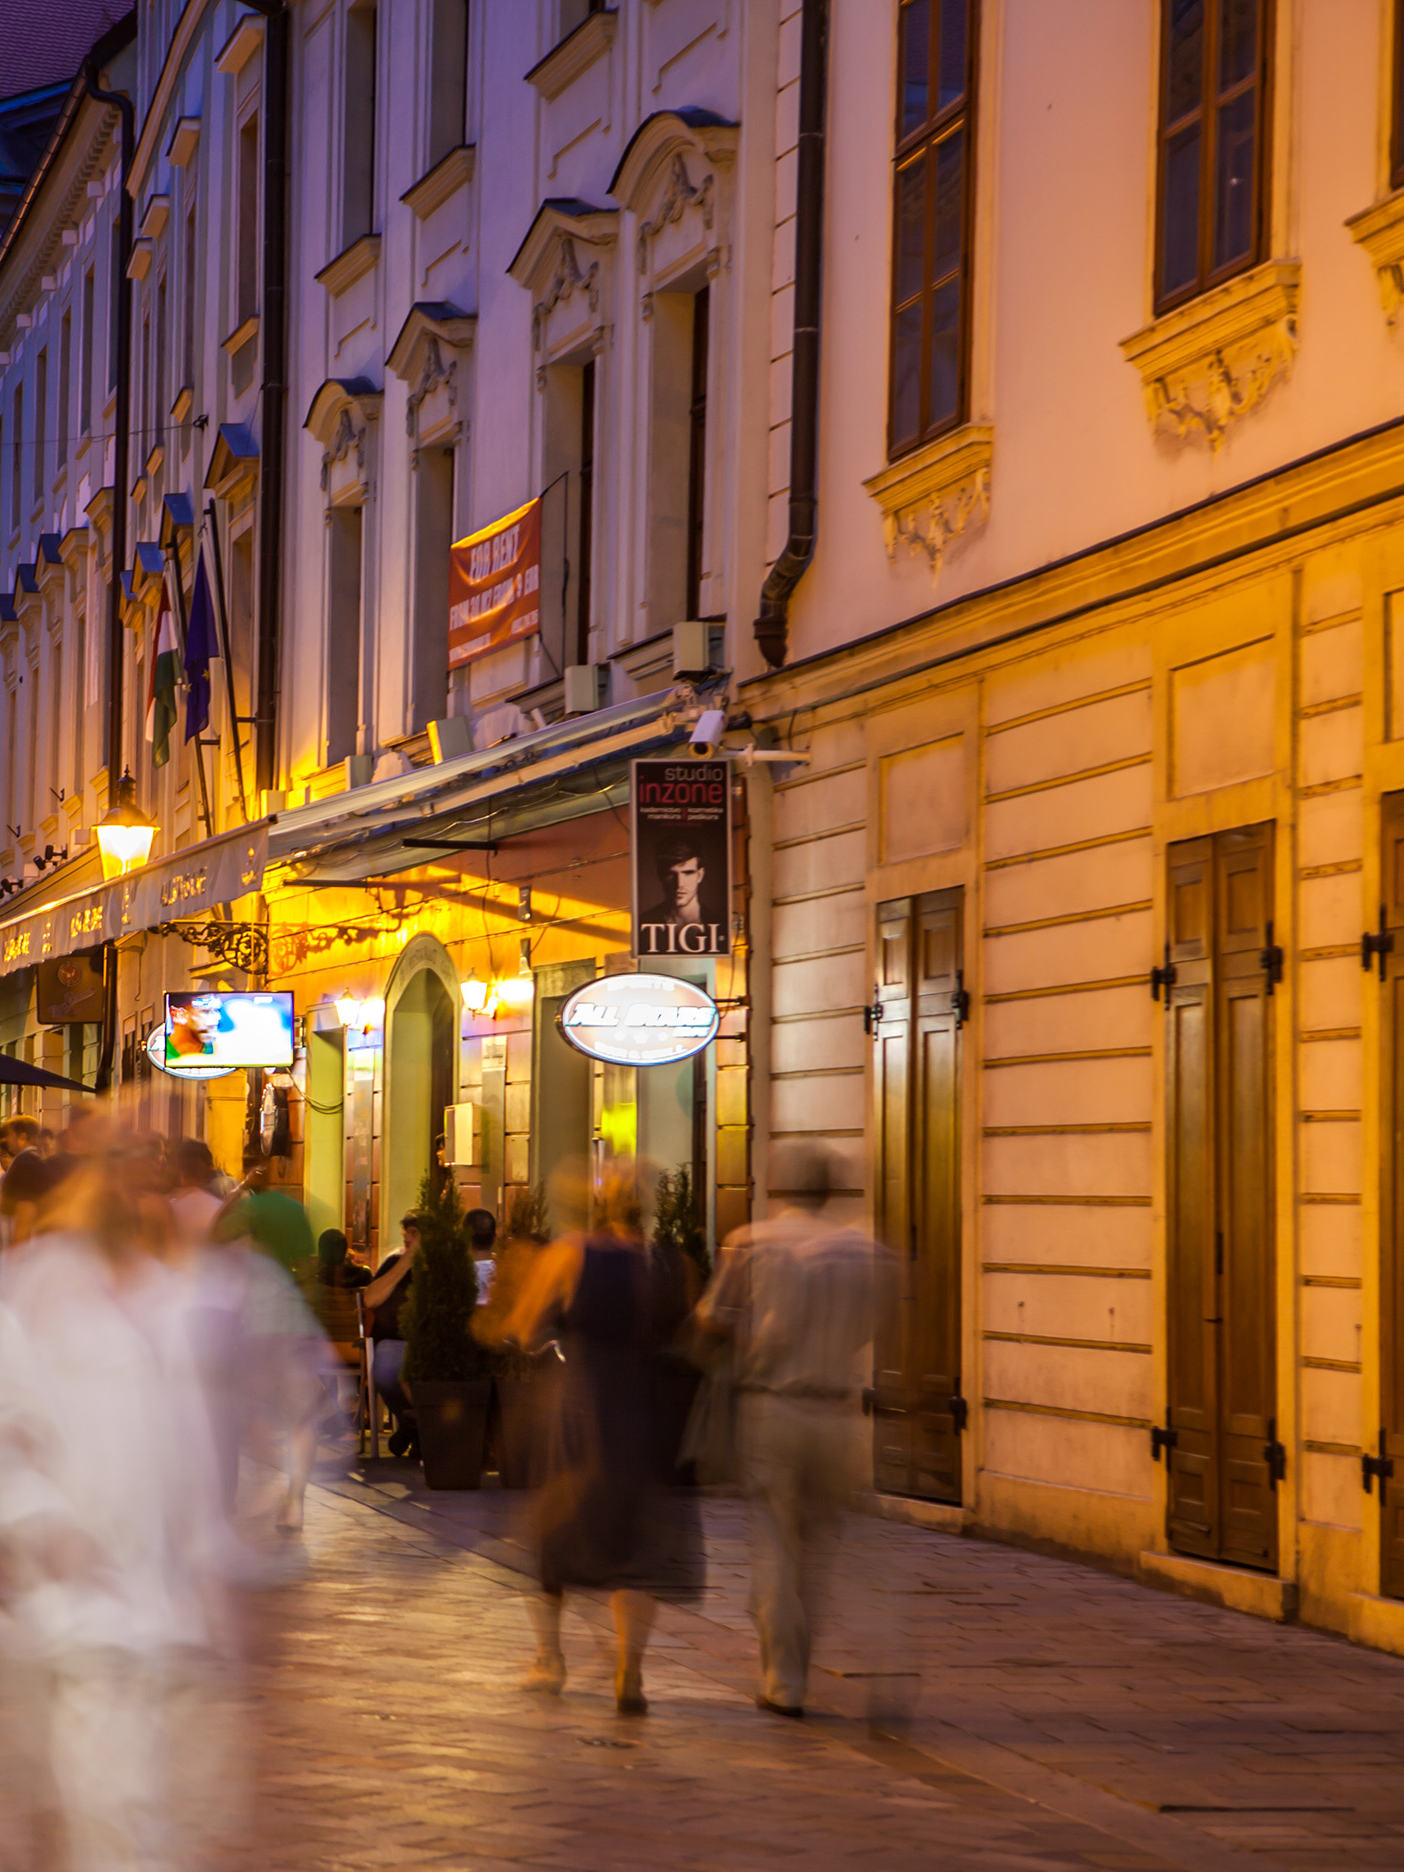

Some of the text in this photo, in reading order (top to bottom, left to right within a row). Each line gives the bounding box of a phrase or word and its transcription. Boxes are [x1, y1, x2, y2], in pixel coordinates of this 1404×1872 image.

[469, 523, 521, 586] FOR RENT
[665, 764, 724, 781] studio
[639, 776, 724, 804] inzone
[640, 922, 720, 953] TIGI
[565, 1002, 620, 1027] ALL
